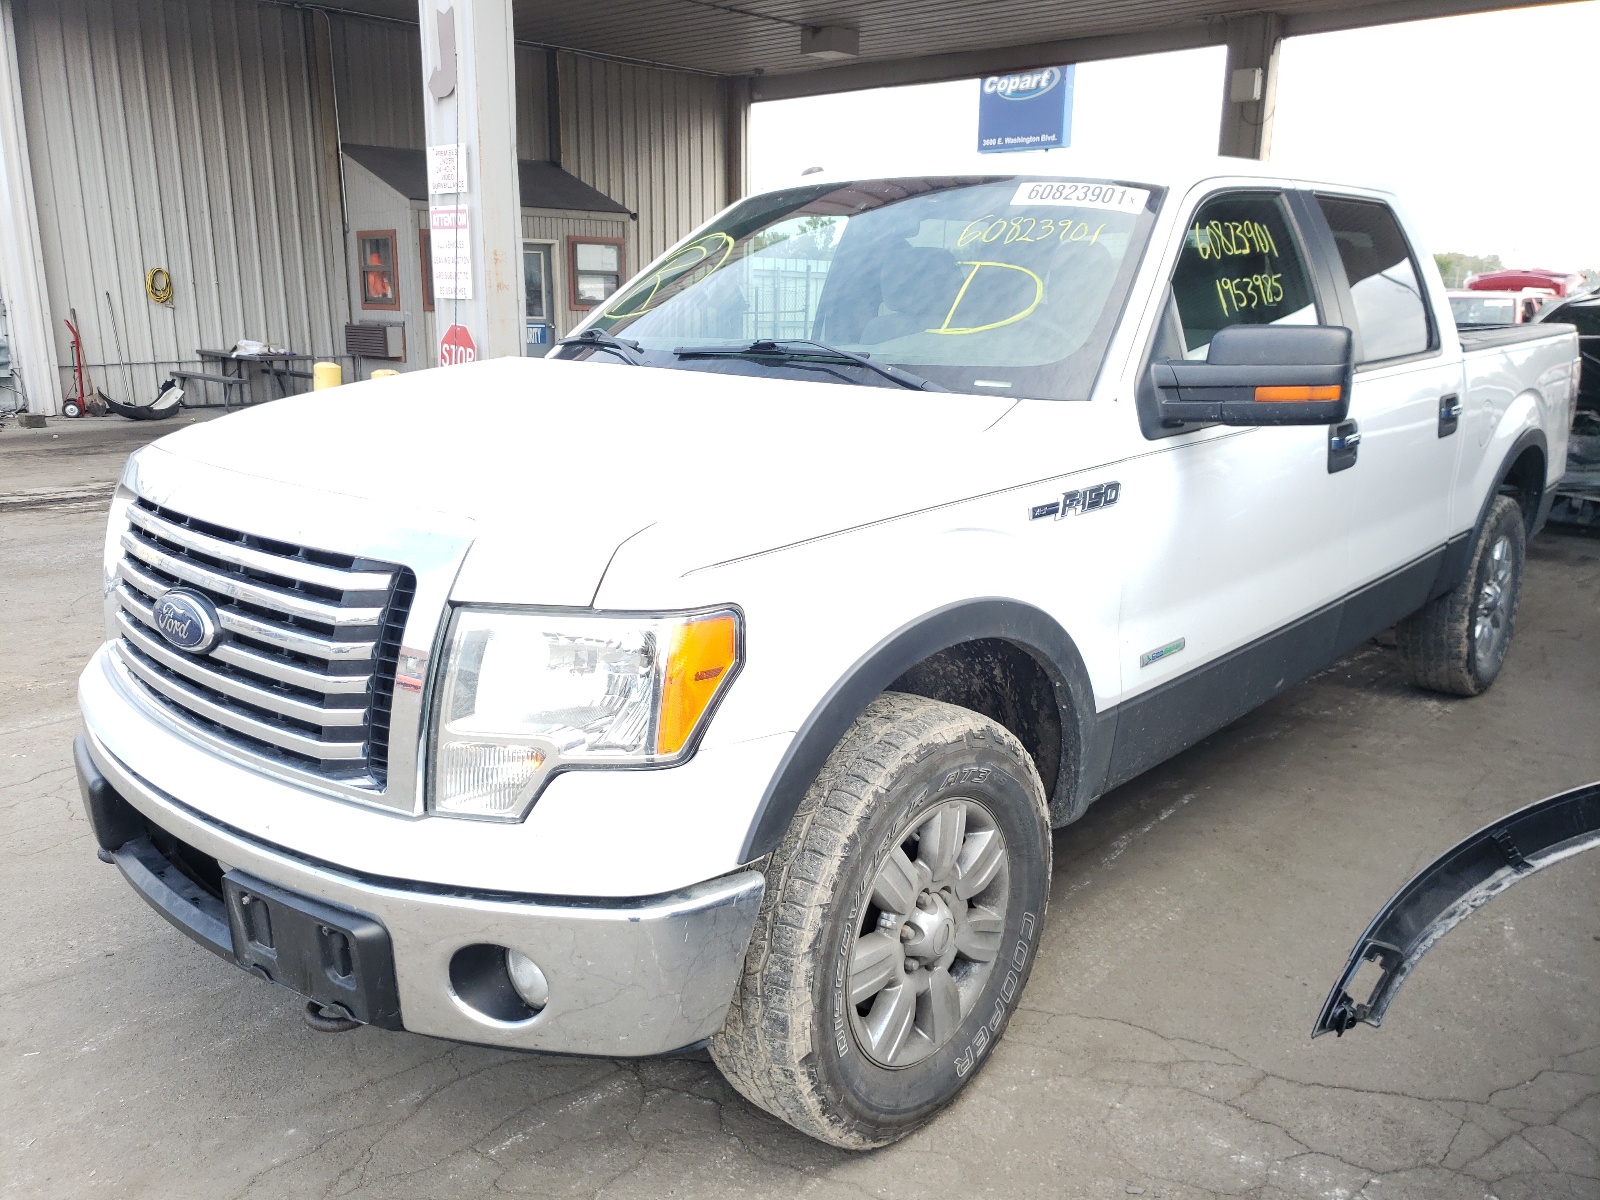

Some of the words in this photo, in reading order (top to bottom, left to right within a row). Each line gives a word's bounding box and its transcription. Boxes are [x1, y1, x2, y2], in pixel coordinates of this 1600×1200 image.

[983, 68, 1051, 96] Copart
[1005, 135, 1040, 145] Washington
[1041, 133, 1058, 142] Blvd.
[1027, 184, 1126, 205] 60823901
[957, 215, 1107, 248] 60823901
[1195, 220, 1279, 260] 60823901
[925, 261, 1044, 335] D
[1216, 273, 1284, 317] 1953985
[441, 343, 475, 367] STOP
[159, 602, 192, 639] Ford
[937, 766, 992, 793] AT3
[954, 911, 1036, 1078] COOPER
